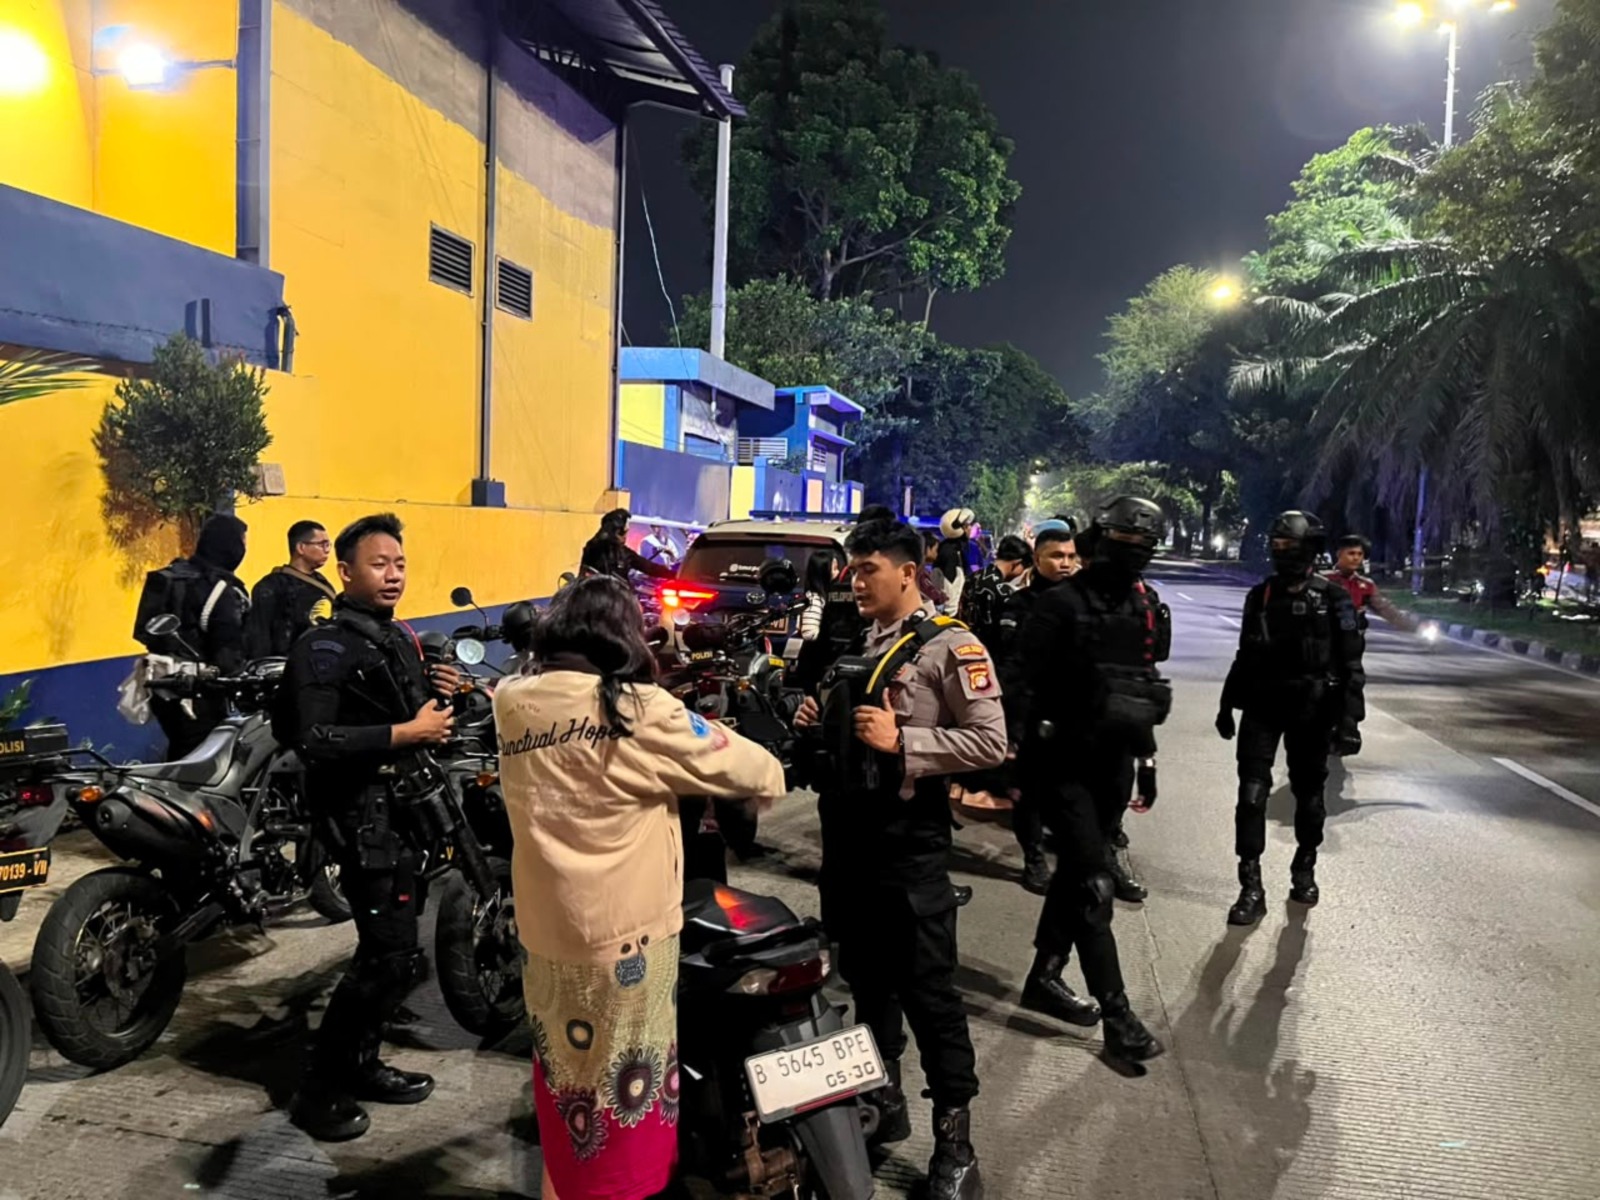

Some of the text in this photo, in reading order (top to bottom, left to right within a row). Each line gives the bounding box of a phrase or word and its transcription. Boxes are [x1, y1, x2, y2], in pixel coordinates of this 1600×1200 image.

[753, 1033, 870, 1085] B 5645 BPE
